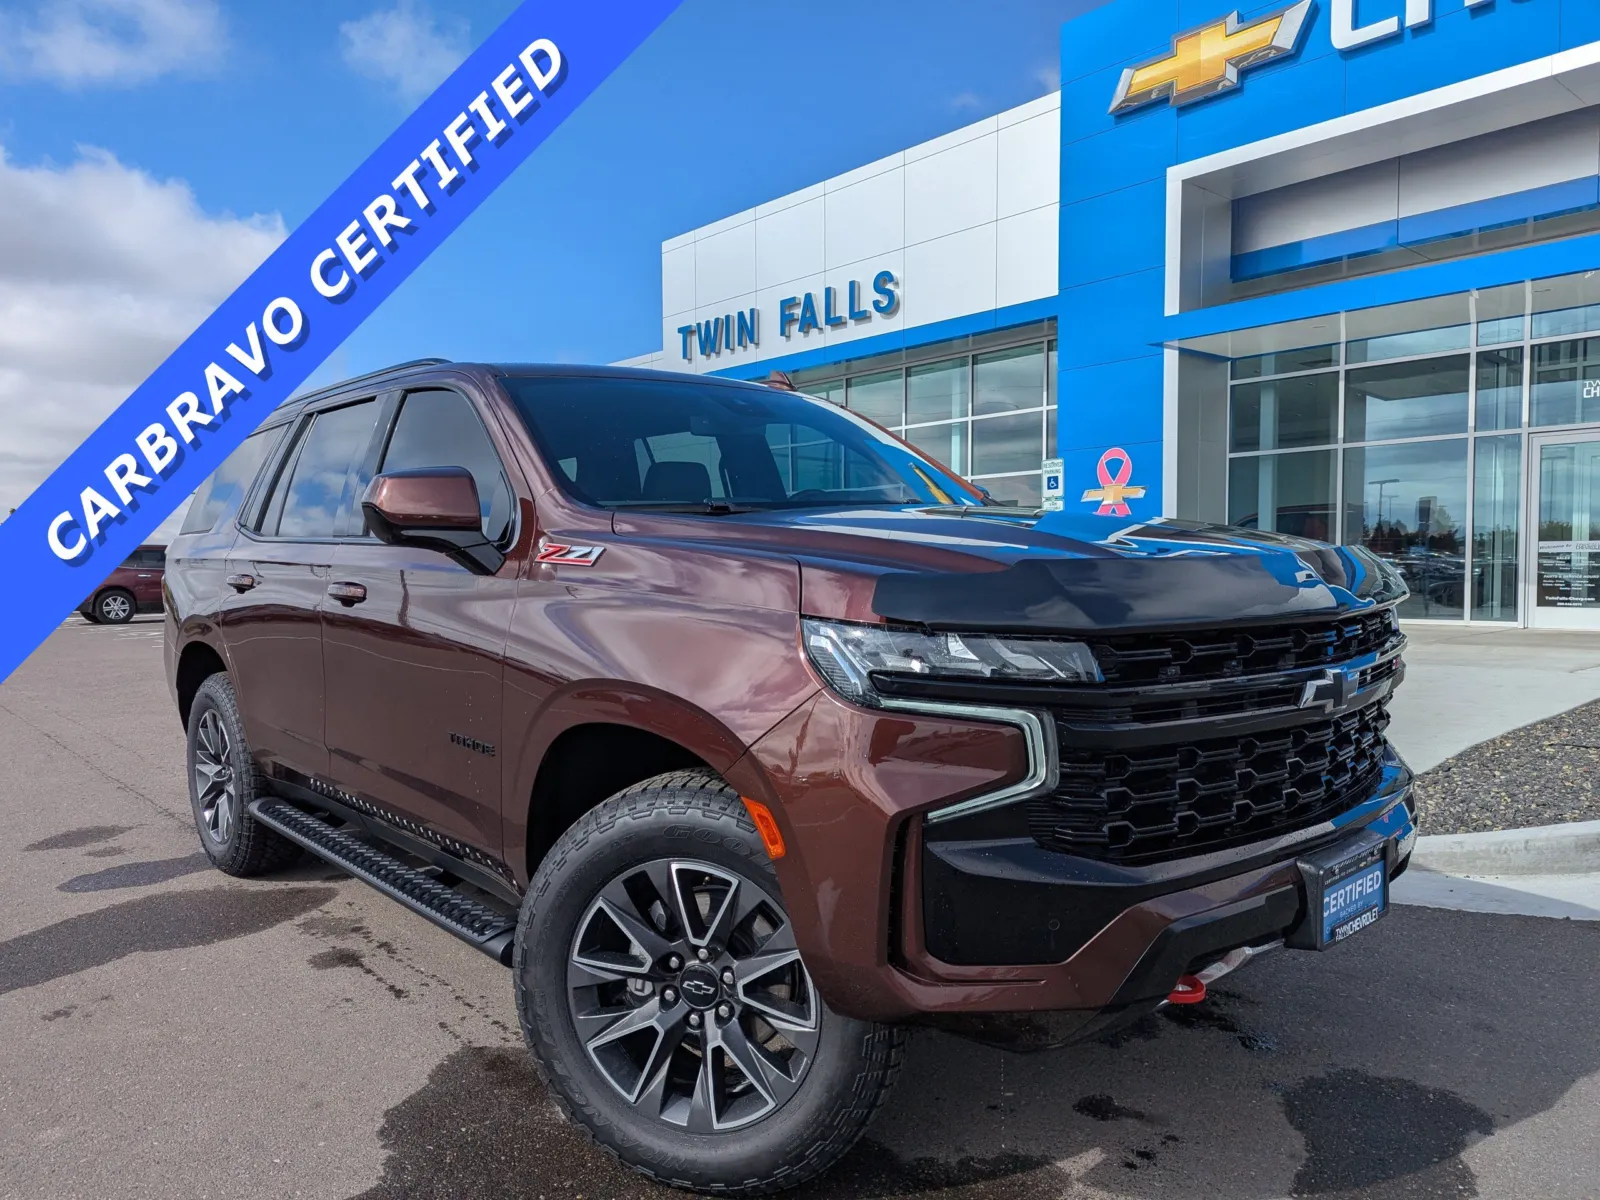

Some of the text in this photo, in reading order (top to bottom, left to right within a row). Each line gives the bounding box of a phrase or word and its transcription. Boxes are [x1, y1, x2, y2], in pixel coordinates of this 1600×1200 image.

[677, 270, 900, 361] TWIN FALLS
[1043, 461, 1063, 469] RESERVED
[535, 542, 606, 567] Z71
[1323, 870, 1382, 918] CERTIFIED
[1348, 906, 1379, 935] CHEVROLET
